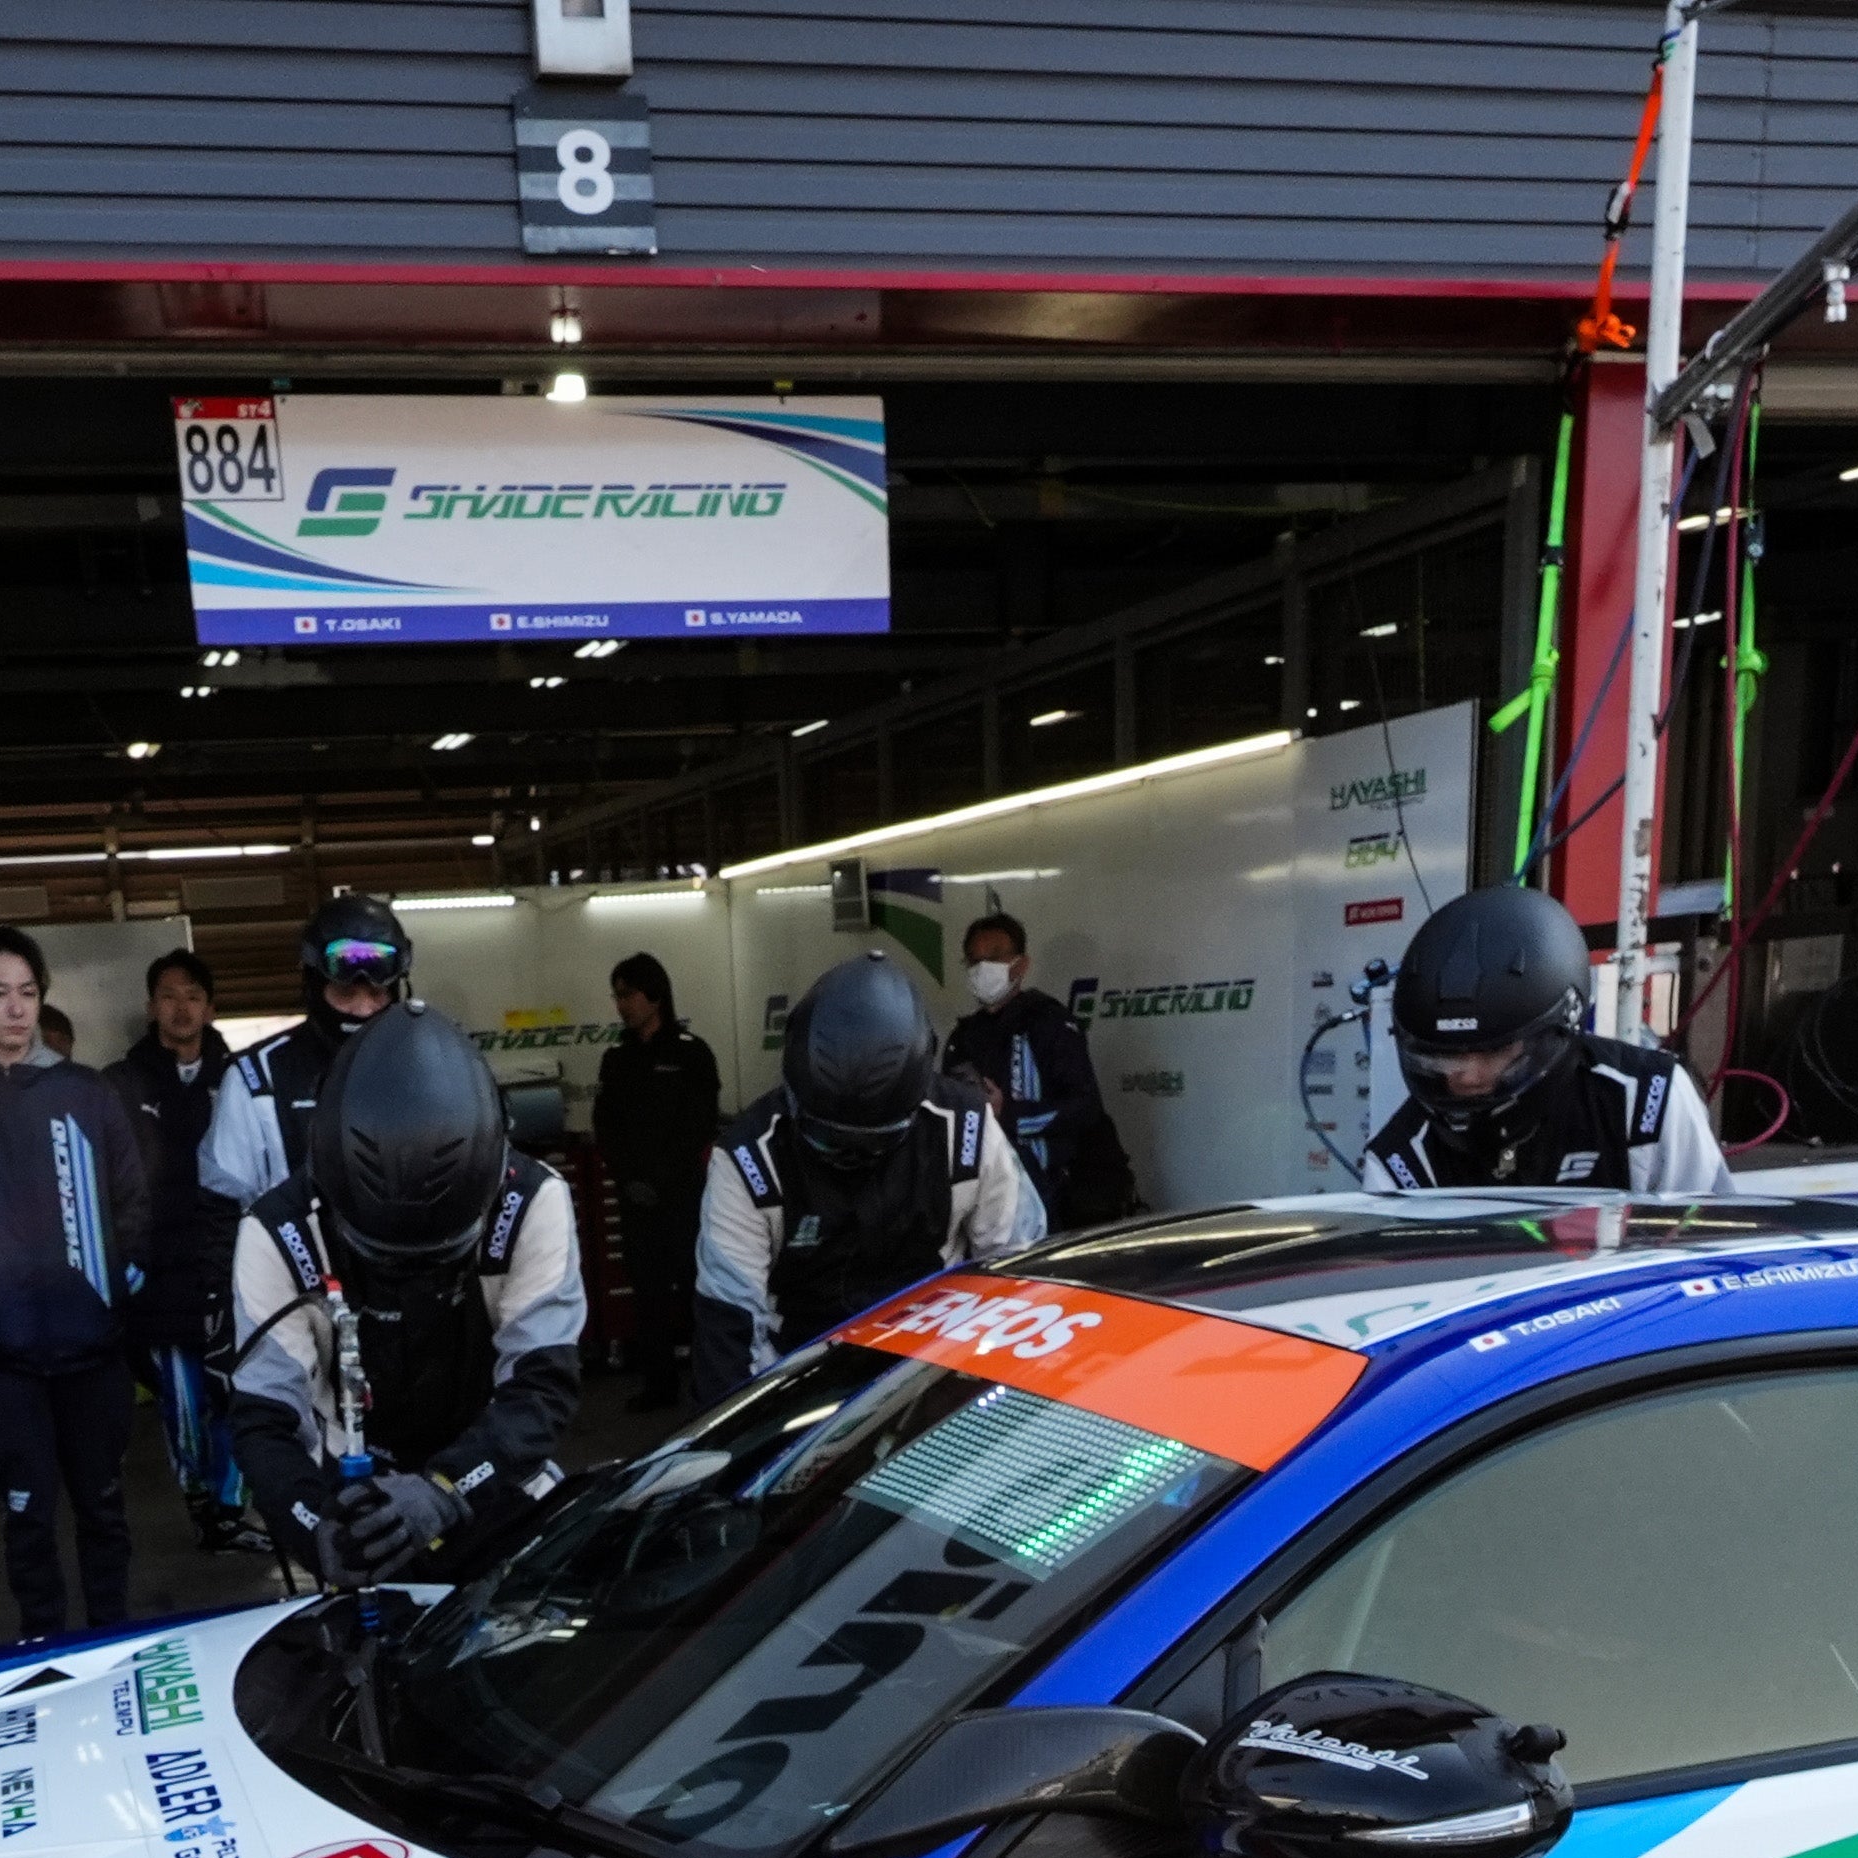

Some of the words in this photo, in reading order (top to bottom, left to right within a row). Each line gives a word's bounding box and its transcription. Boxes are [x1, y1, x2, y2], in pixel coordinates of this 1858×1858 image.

[556, 130, 615, 214] 8
[185, 424, 275, 494] 884
[325, 618, 401, 633] T.OSAKI
[959, 1110, 981, 1168] sparco
[277, 1221, 319, 1291] sparco
[907, 1291, 1103, 1360] ENEOS
[1513, 1295, 1622, 1338] T.OSAKI
[113, 1679, 134, 1737] TELEMPU
[139, 1637, 203, 1735] HAYASHI
[0, 1767, 37, 1838] NEVHA
[146, 1748, 223, 1822] ADLER
